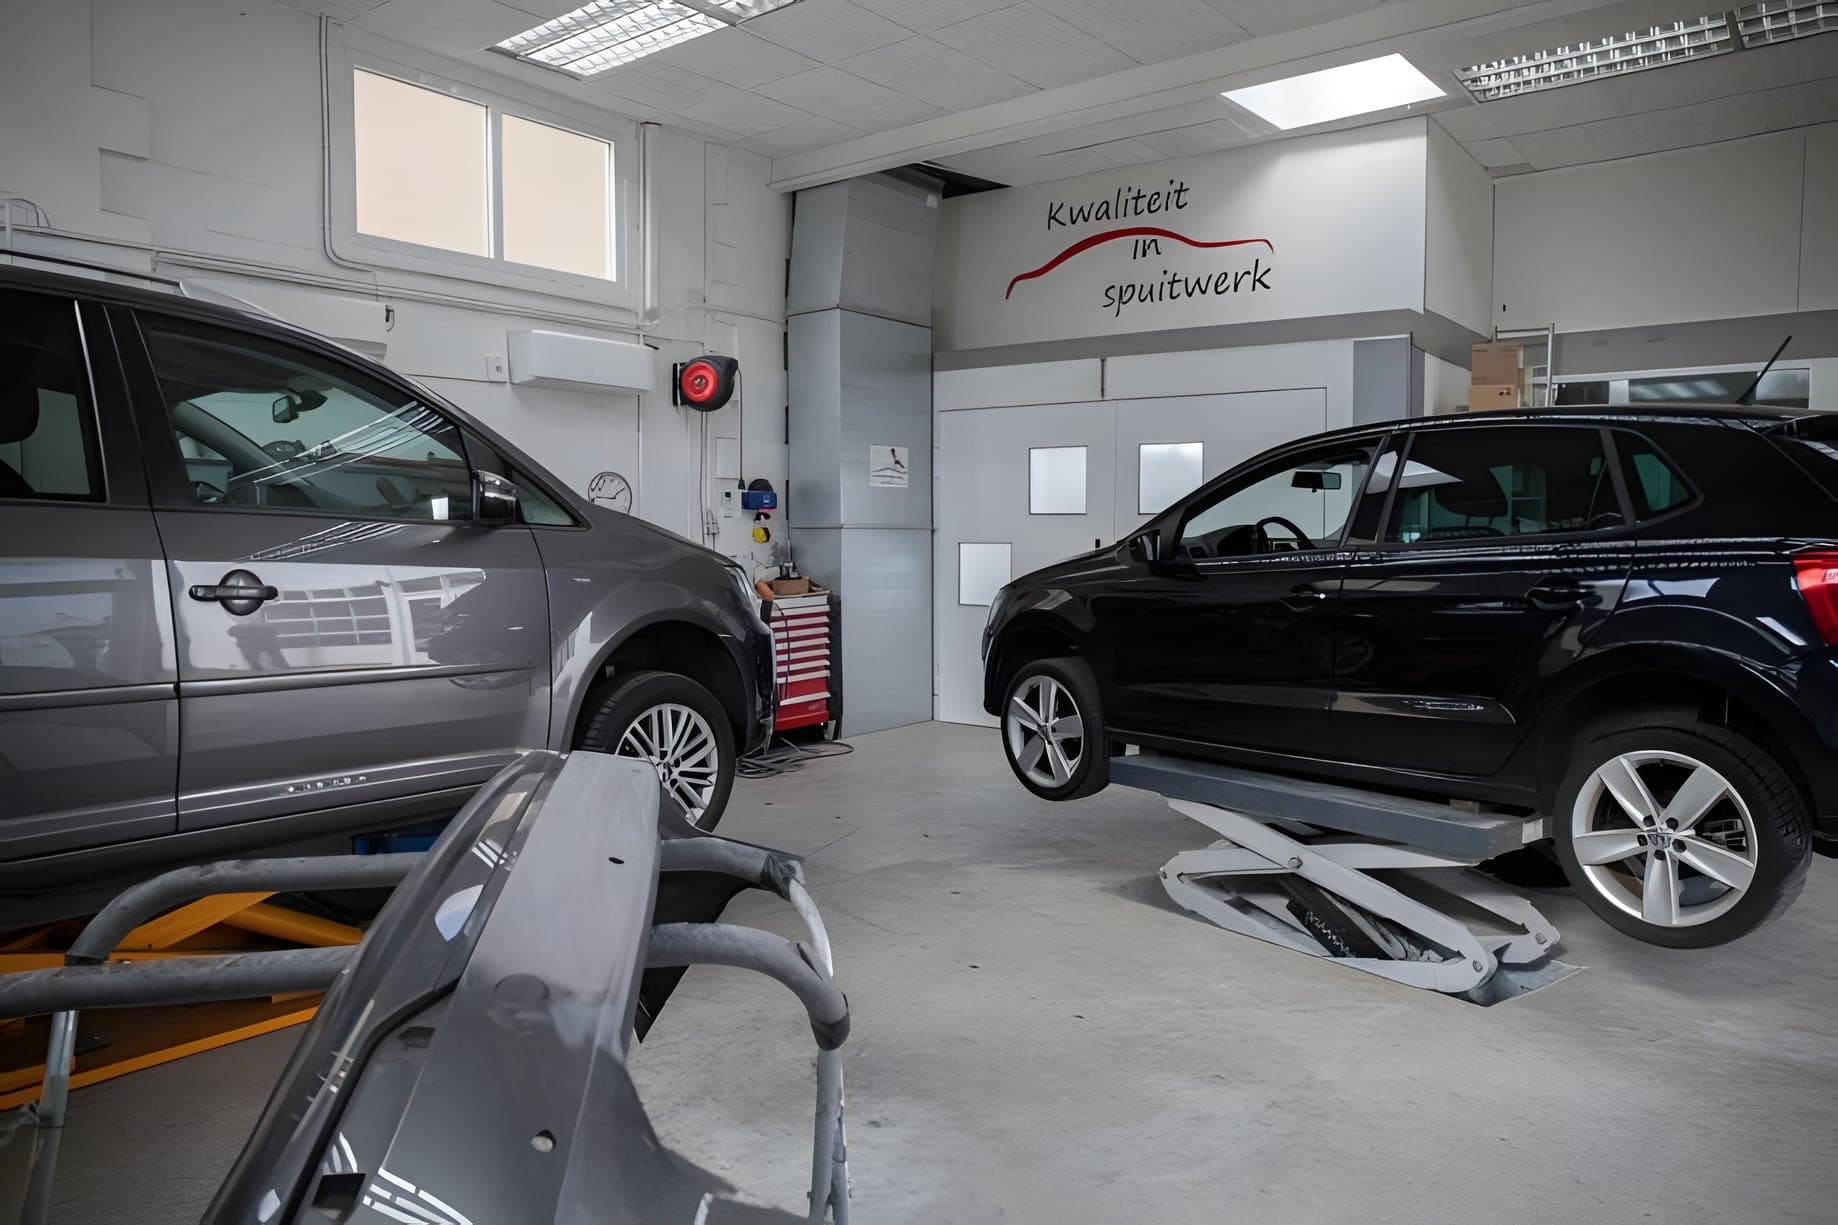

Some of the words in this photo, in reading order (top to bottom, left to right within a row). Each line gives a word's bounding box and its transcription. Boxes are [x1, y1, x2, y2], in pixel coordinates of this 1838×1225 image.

[1047, 179, 1190, 230] Kwaliteit
[1132, 238, 1162, 260] in
[1102, 258, 1272, 318] spuitwerk
